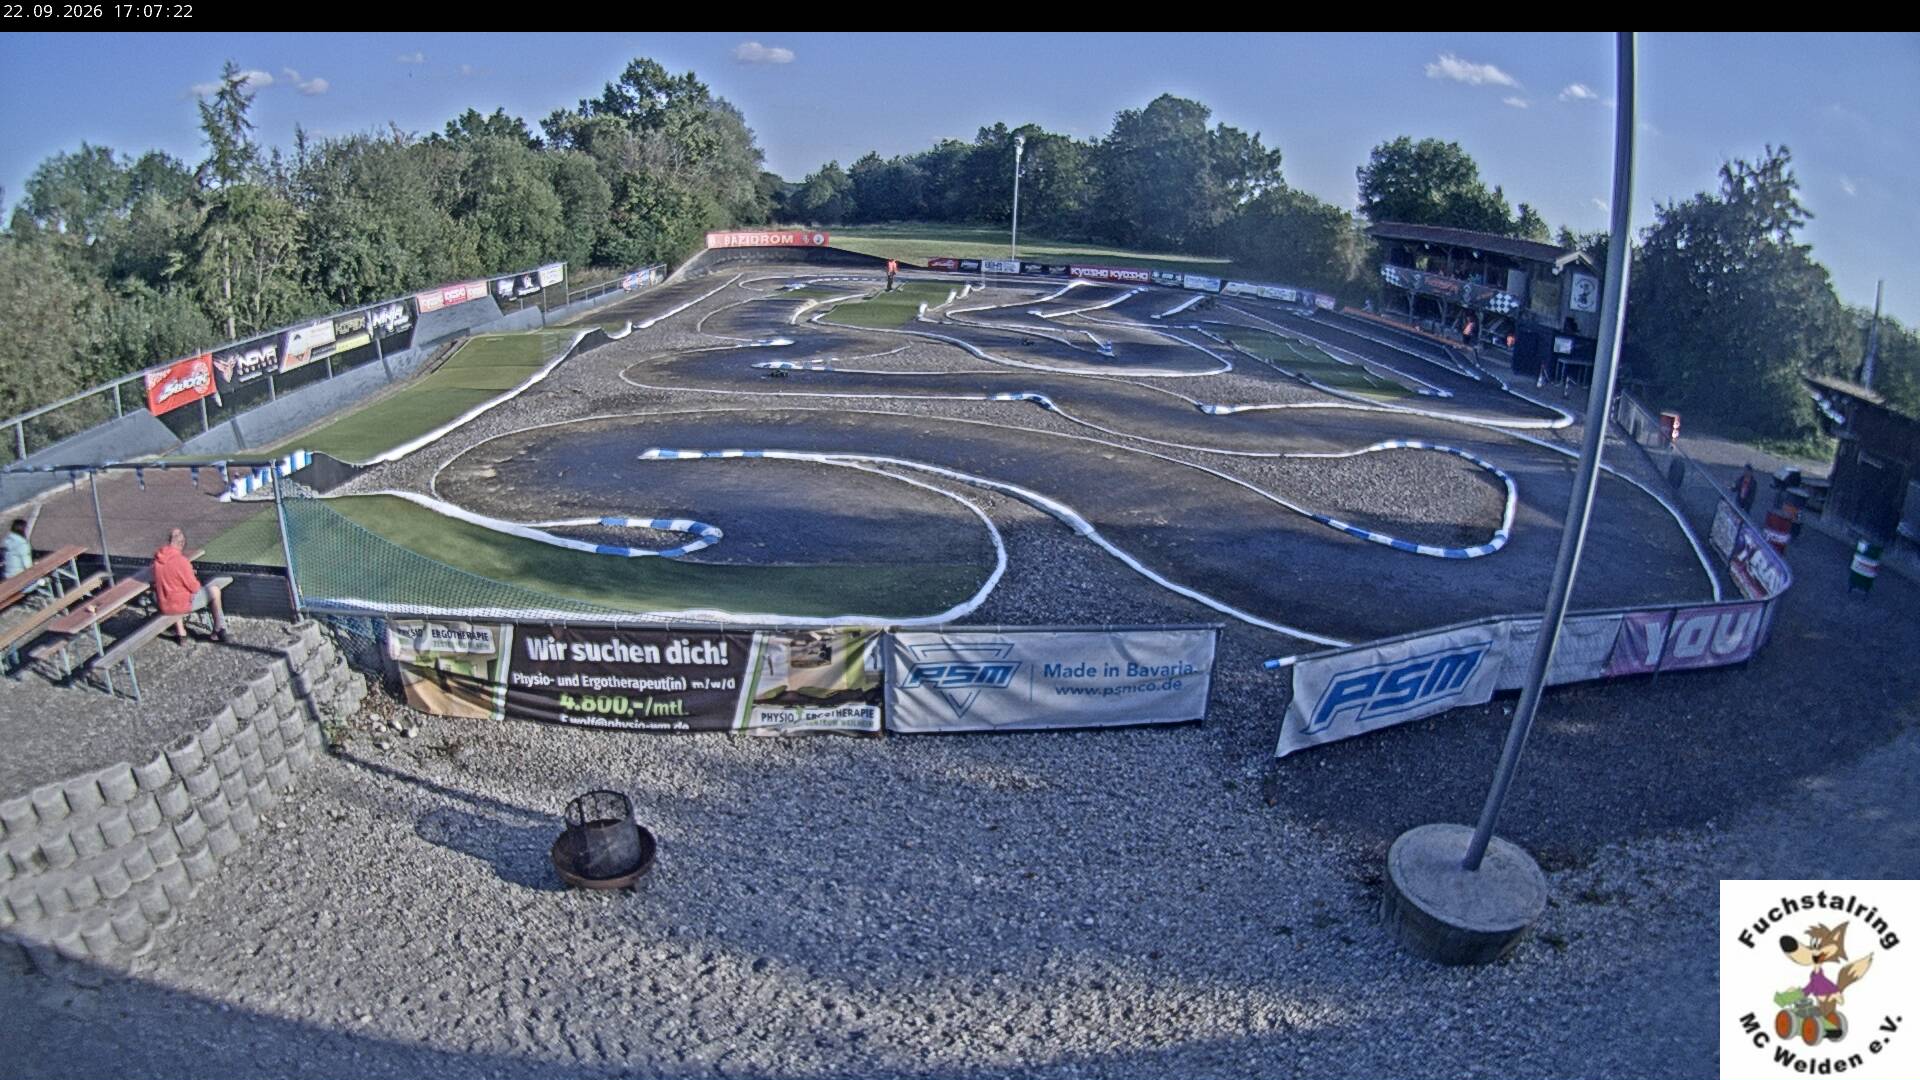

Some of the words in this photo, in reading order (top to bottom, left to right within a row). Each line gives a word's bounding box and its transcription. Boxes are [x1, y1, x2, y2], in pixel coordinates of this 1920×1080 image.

[526, 636, 567, 661] Wir
[572, 638, 661, 664] suchen
[665, 638, 729, 666] dich!
[1044, 662, 1097, 678] Made
[1103, 662, 1120, 677] in
[513, 671, 554, 688] Physio-
[557, 673, 579, 687] und
[583, 675, 687, 692] Ergotherapeut(in)
[691, 677, 736, 690] m/w/d
[1055, 679, 1183, 698] www.psmco.de
[1312, 648, 1485, 725] PSM
[761, 712, 795, 722] PHYSIO
